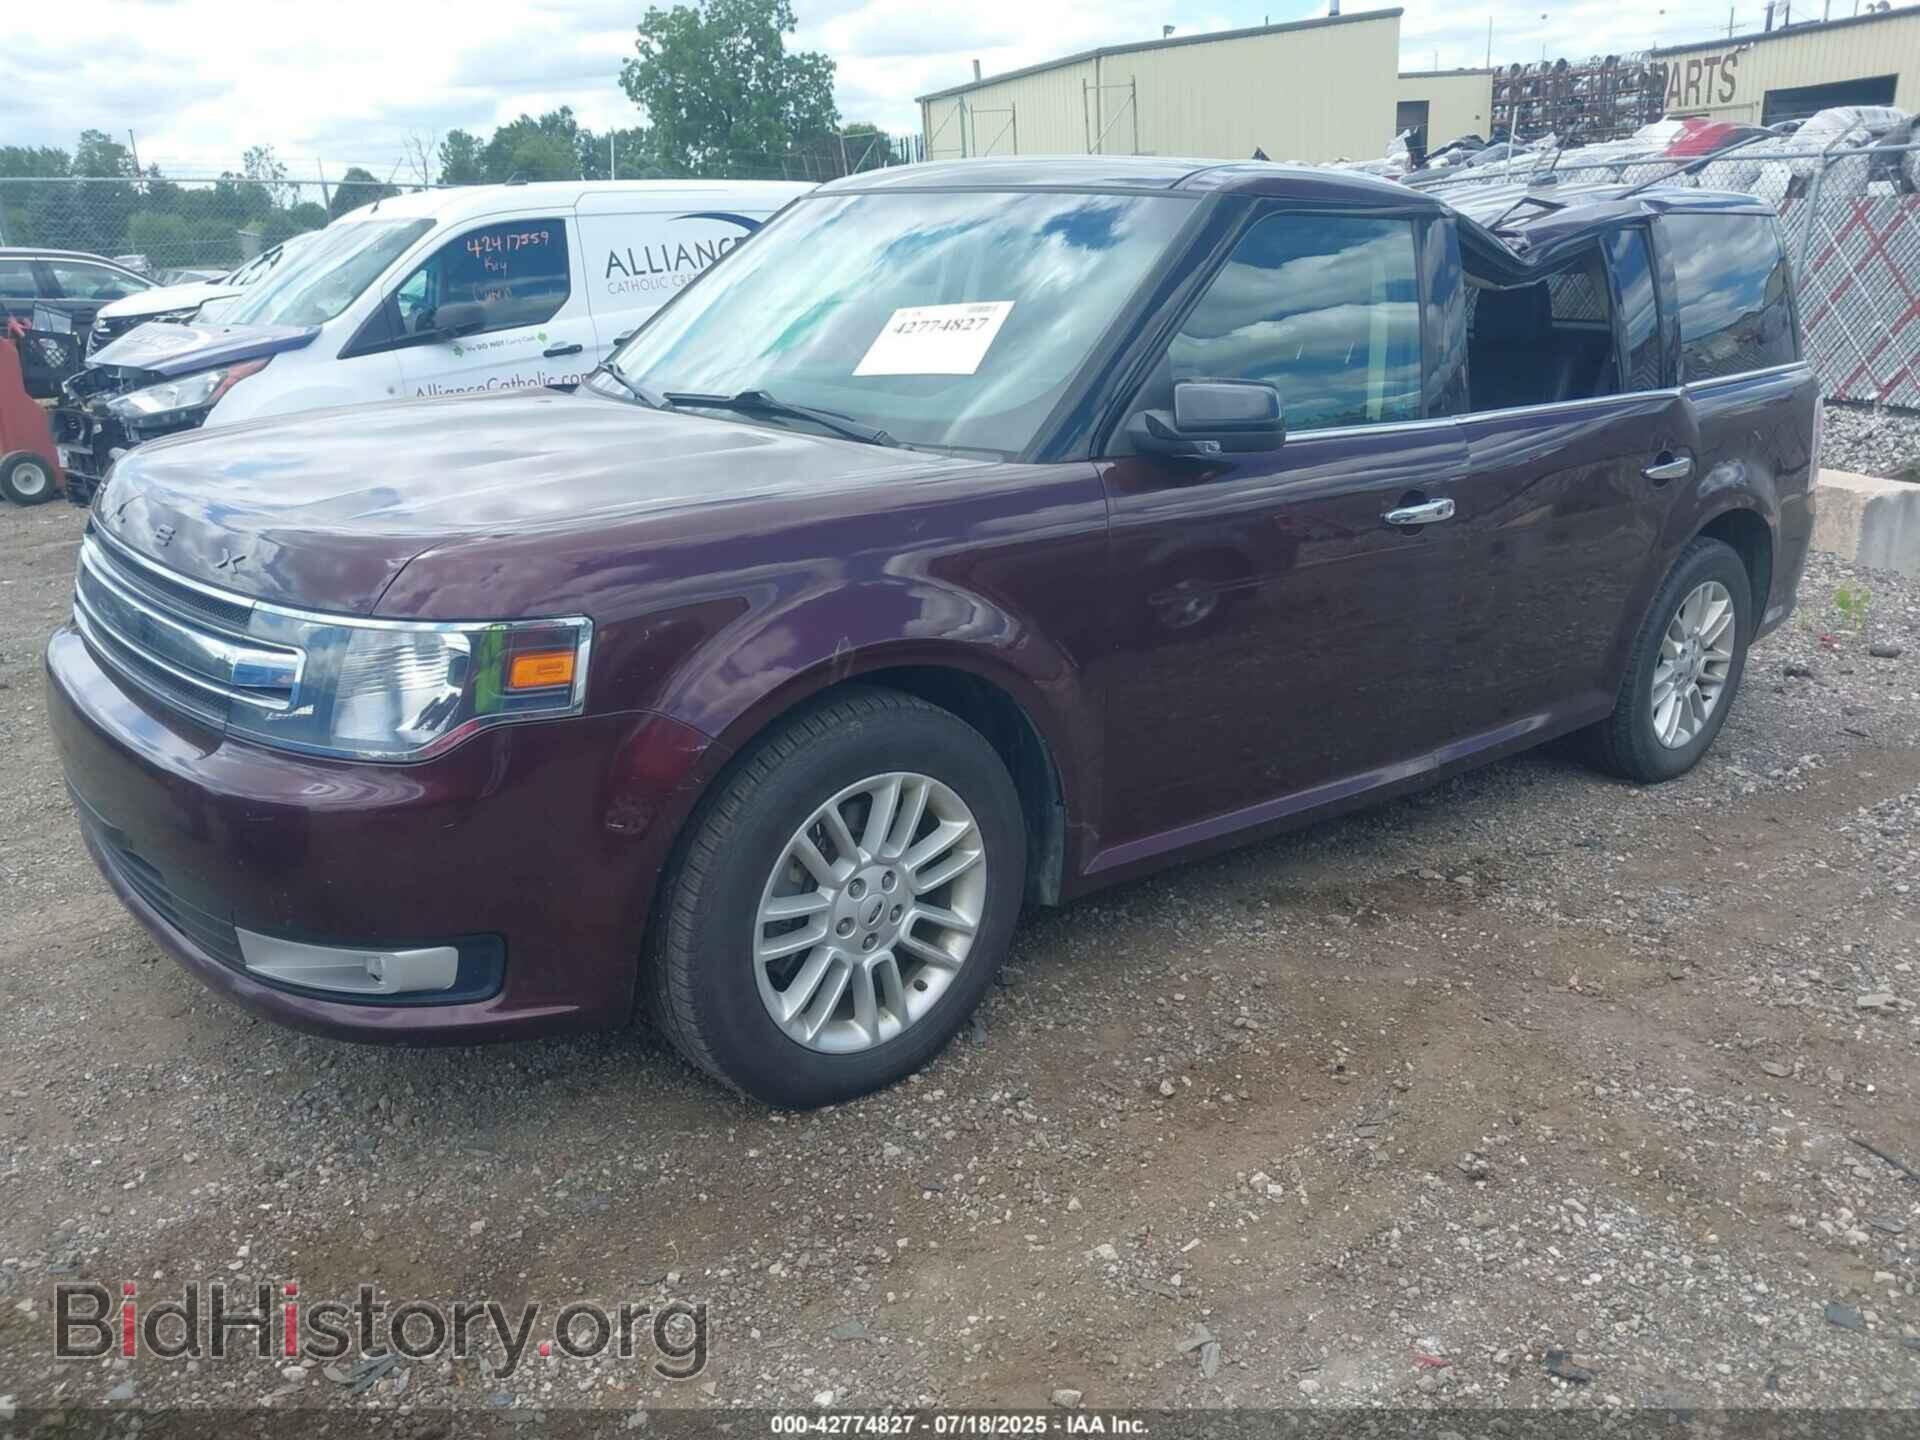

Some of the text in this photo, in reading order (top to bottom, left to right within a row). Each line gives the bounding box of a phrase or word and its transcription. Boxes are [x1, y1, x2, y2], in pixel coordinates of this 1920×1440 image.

[466, 231, 549, 259] 42417559
[607, 275, 669, 295] CATHOLIC
[893, 317, 989, 335] 42774827
[416, 370, 592, 397] AllianceCatholicco
